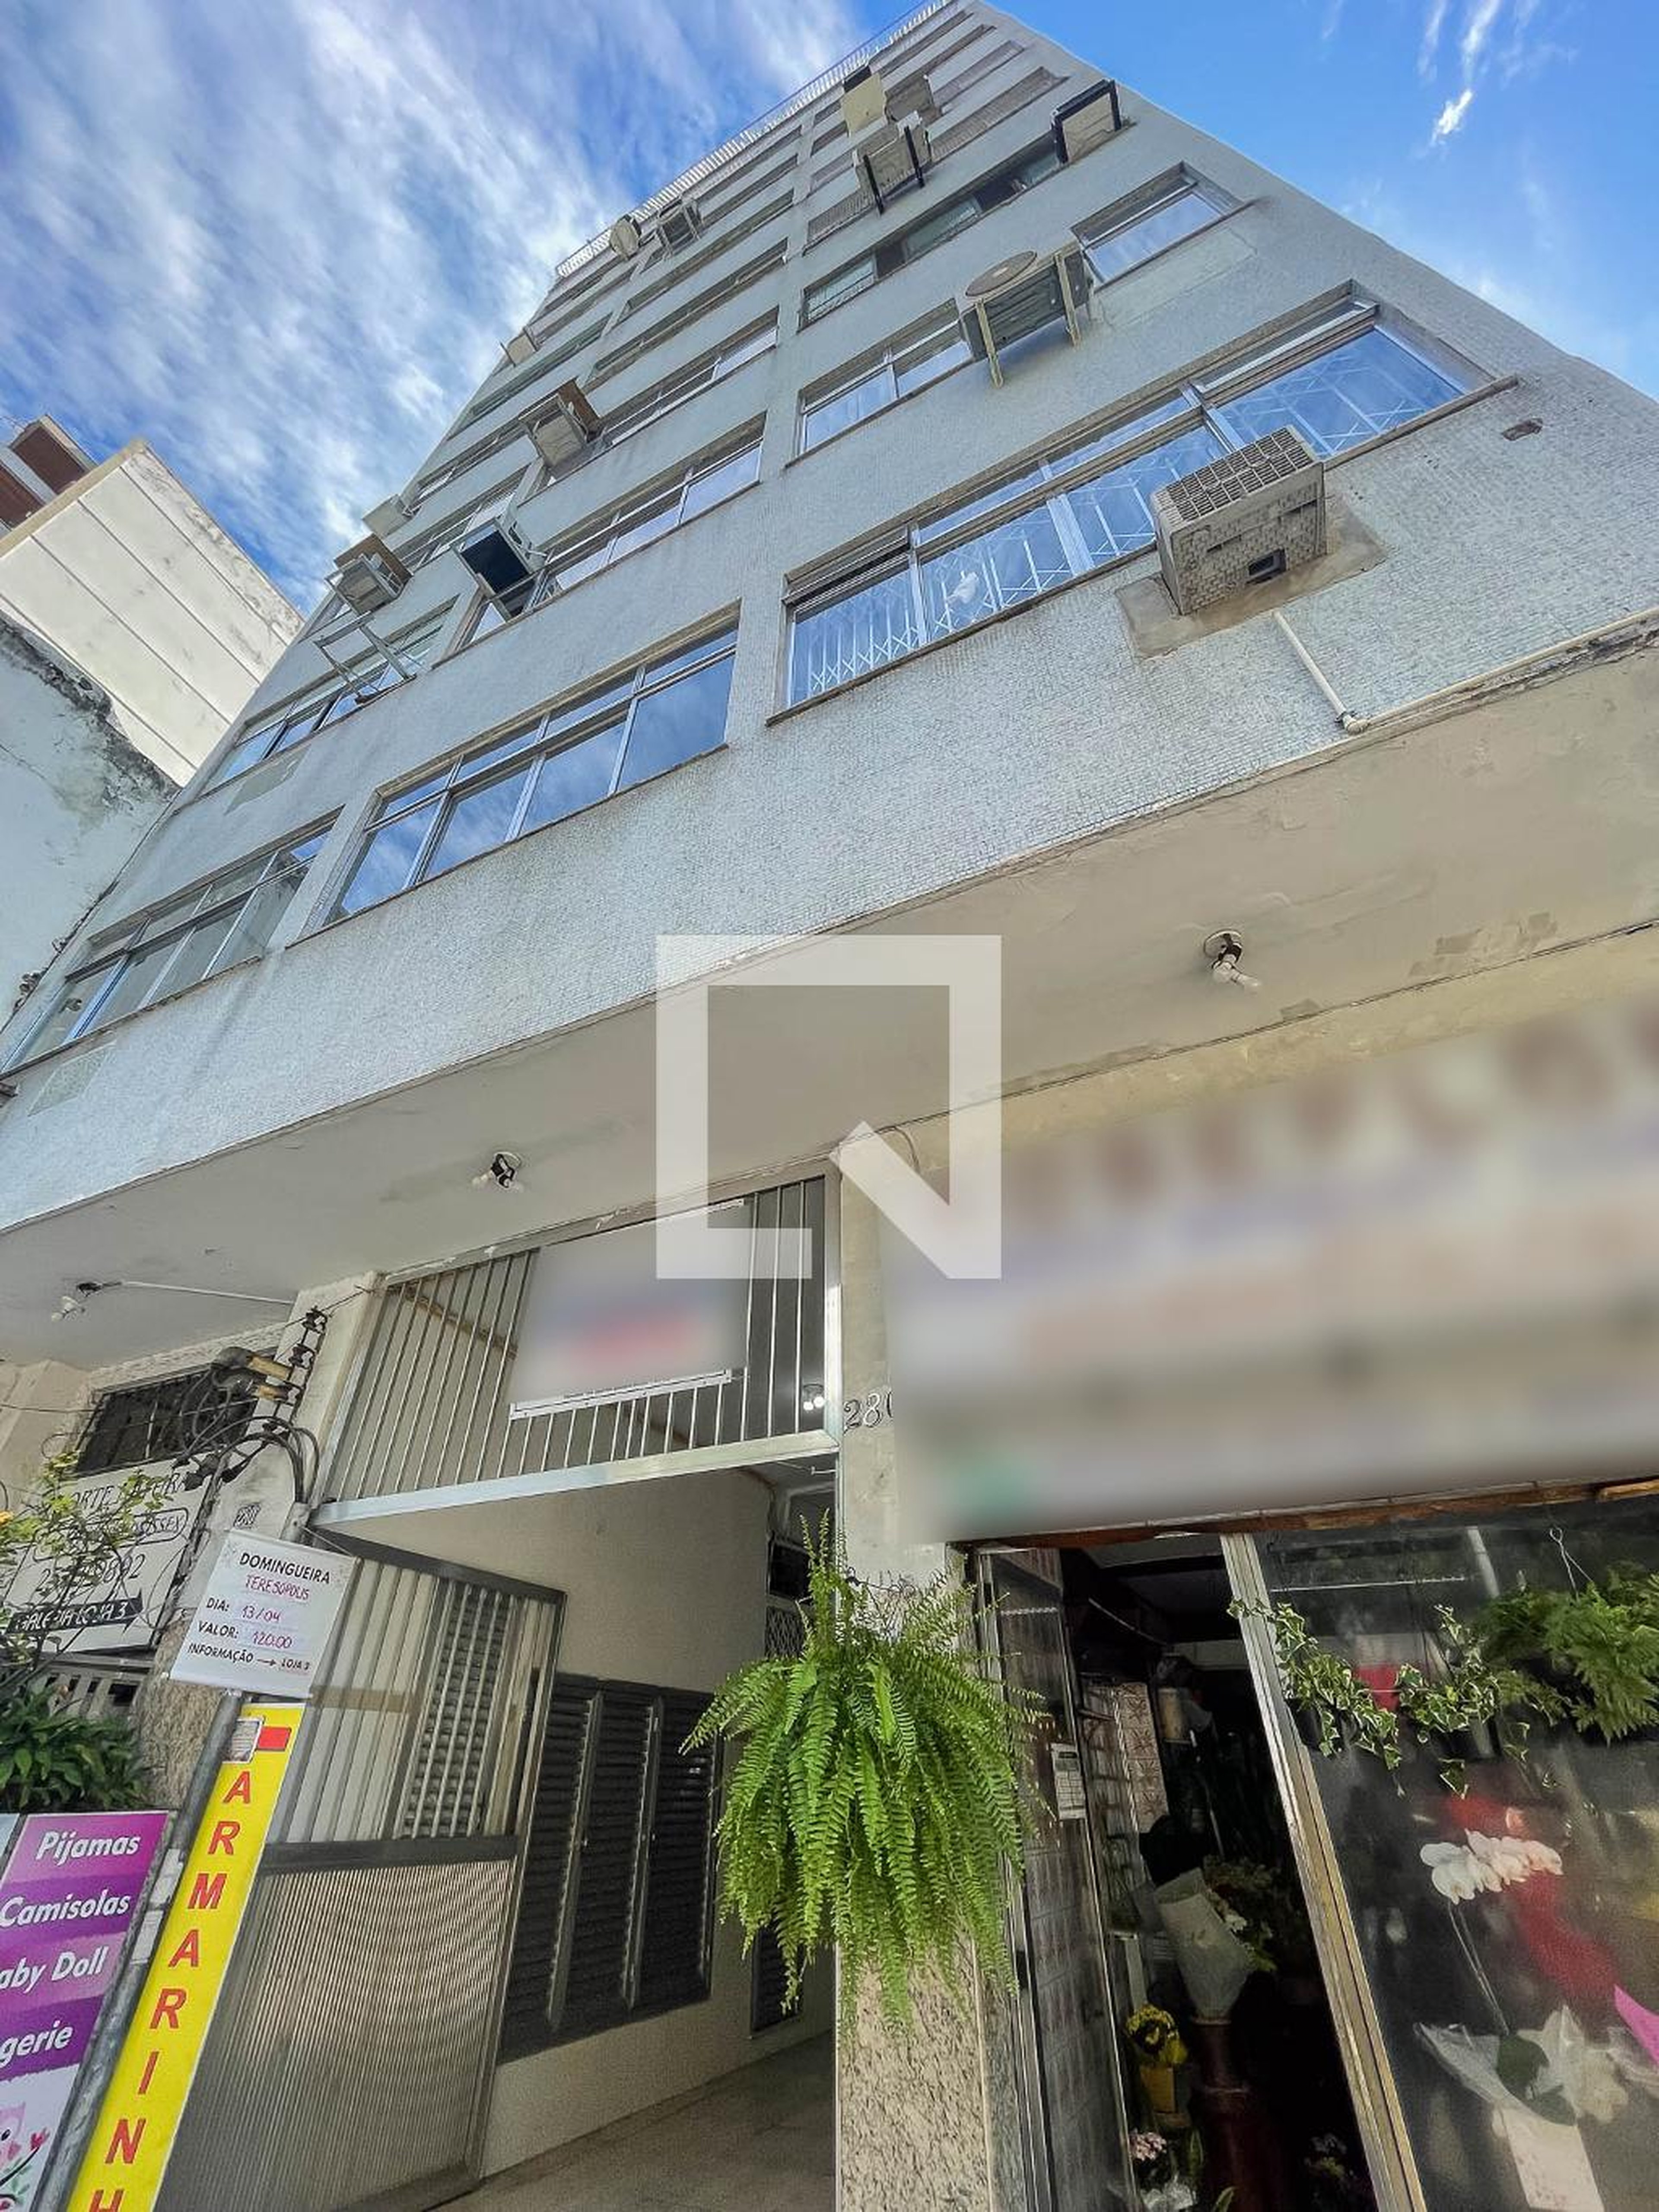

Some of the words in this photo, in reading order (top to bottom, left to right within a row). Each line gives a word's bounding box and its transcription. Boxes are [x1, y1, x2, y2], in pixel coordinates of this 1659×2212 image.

[239, 1552, 330, 1584] DOMINGUEIRA
[206, 1598, 230, 1612] DIA:
[198, 1621, 239, 1639] VALOR:
[188, 1642, 254, 1664] INFORMAÇÃO
[36, 1830, 141, 1865] Pijamas
[0, 1889, 131, 1928] Camisolas
[51, 1945, 109, 1982] Doll
